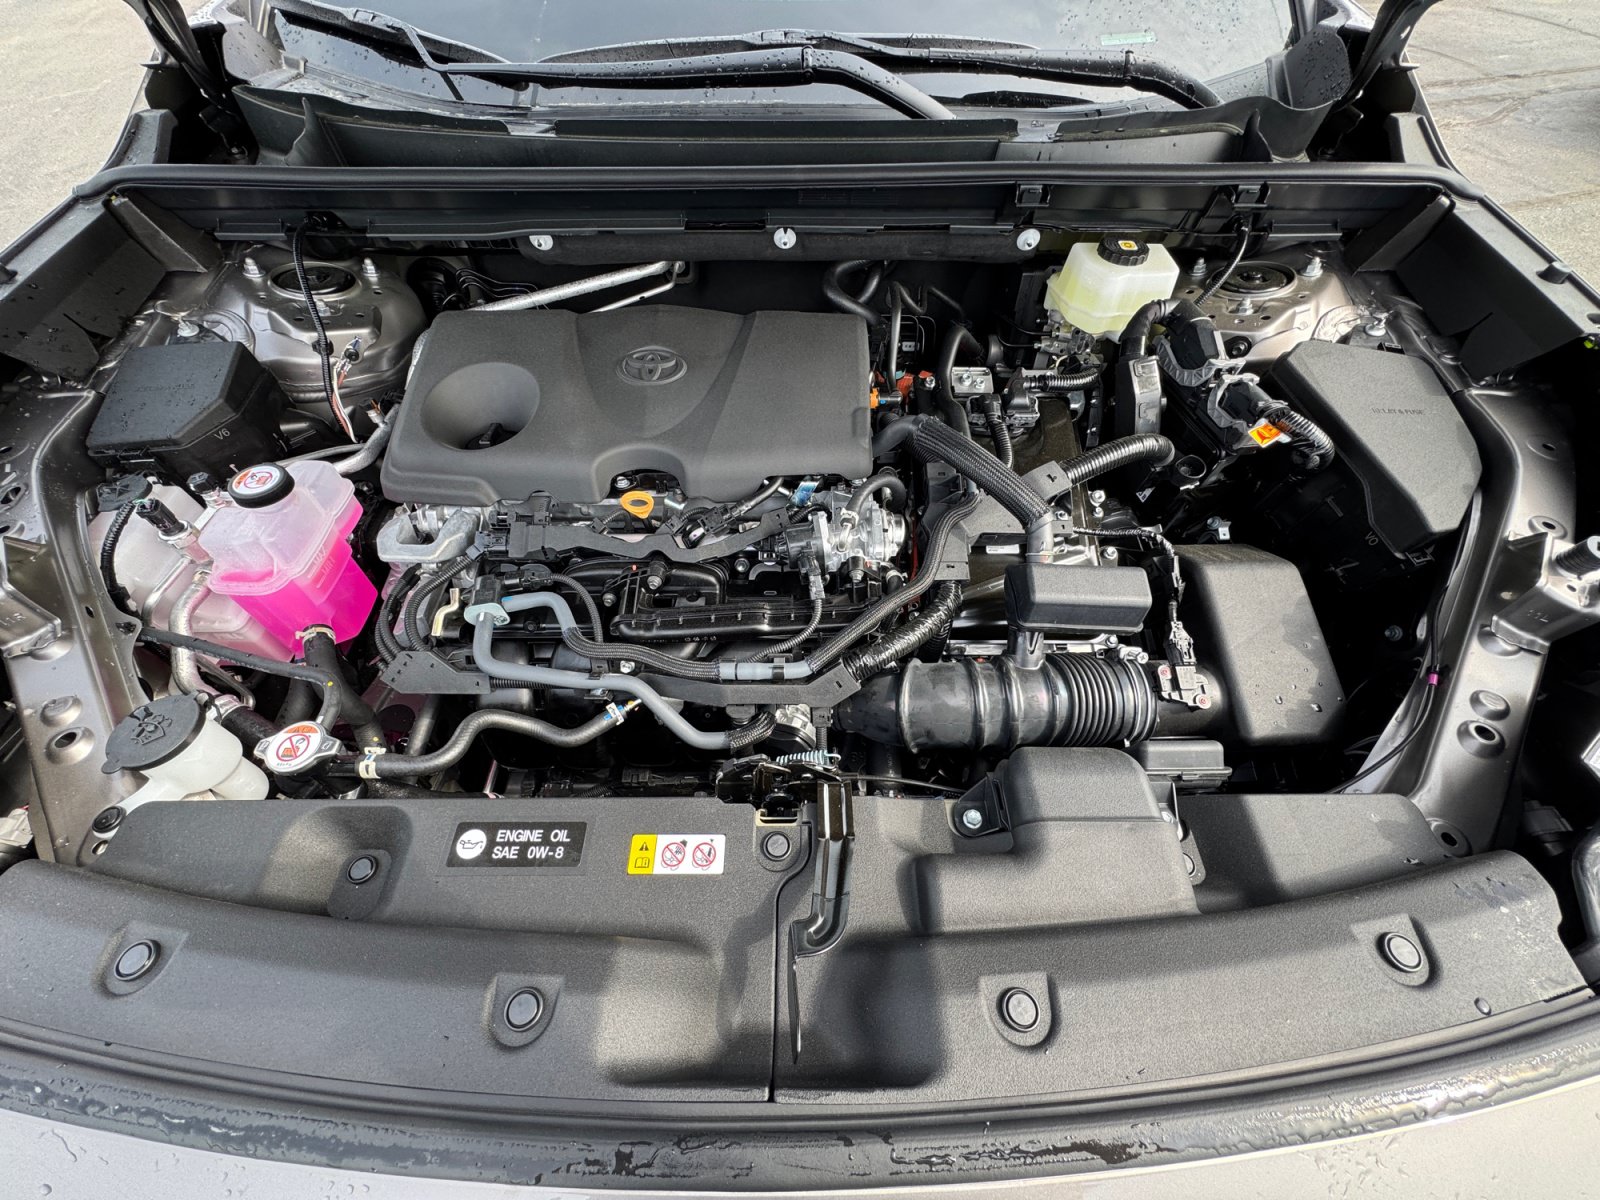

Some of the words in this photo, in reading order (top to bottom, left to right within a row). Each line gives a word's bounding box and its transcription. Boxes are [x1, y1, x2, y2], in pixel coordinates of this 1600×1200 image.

[213, 428, 231, 440] V6
[495, 829, 544, 842] ENGINE
[550, 829, 571, 842] OIL
[491, 846, 520, 859] SAE
[527, 846, 564, 859] 0W-8
